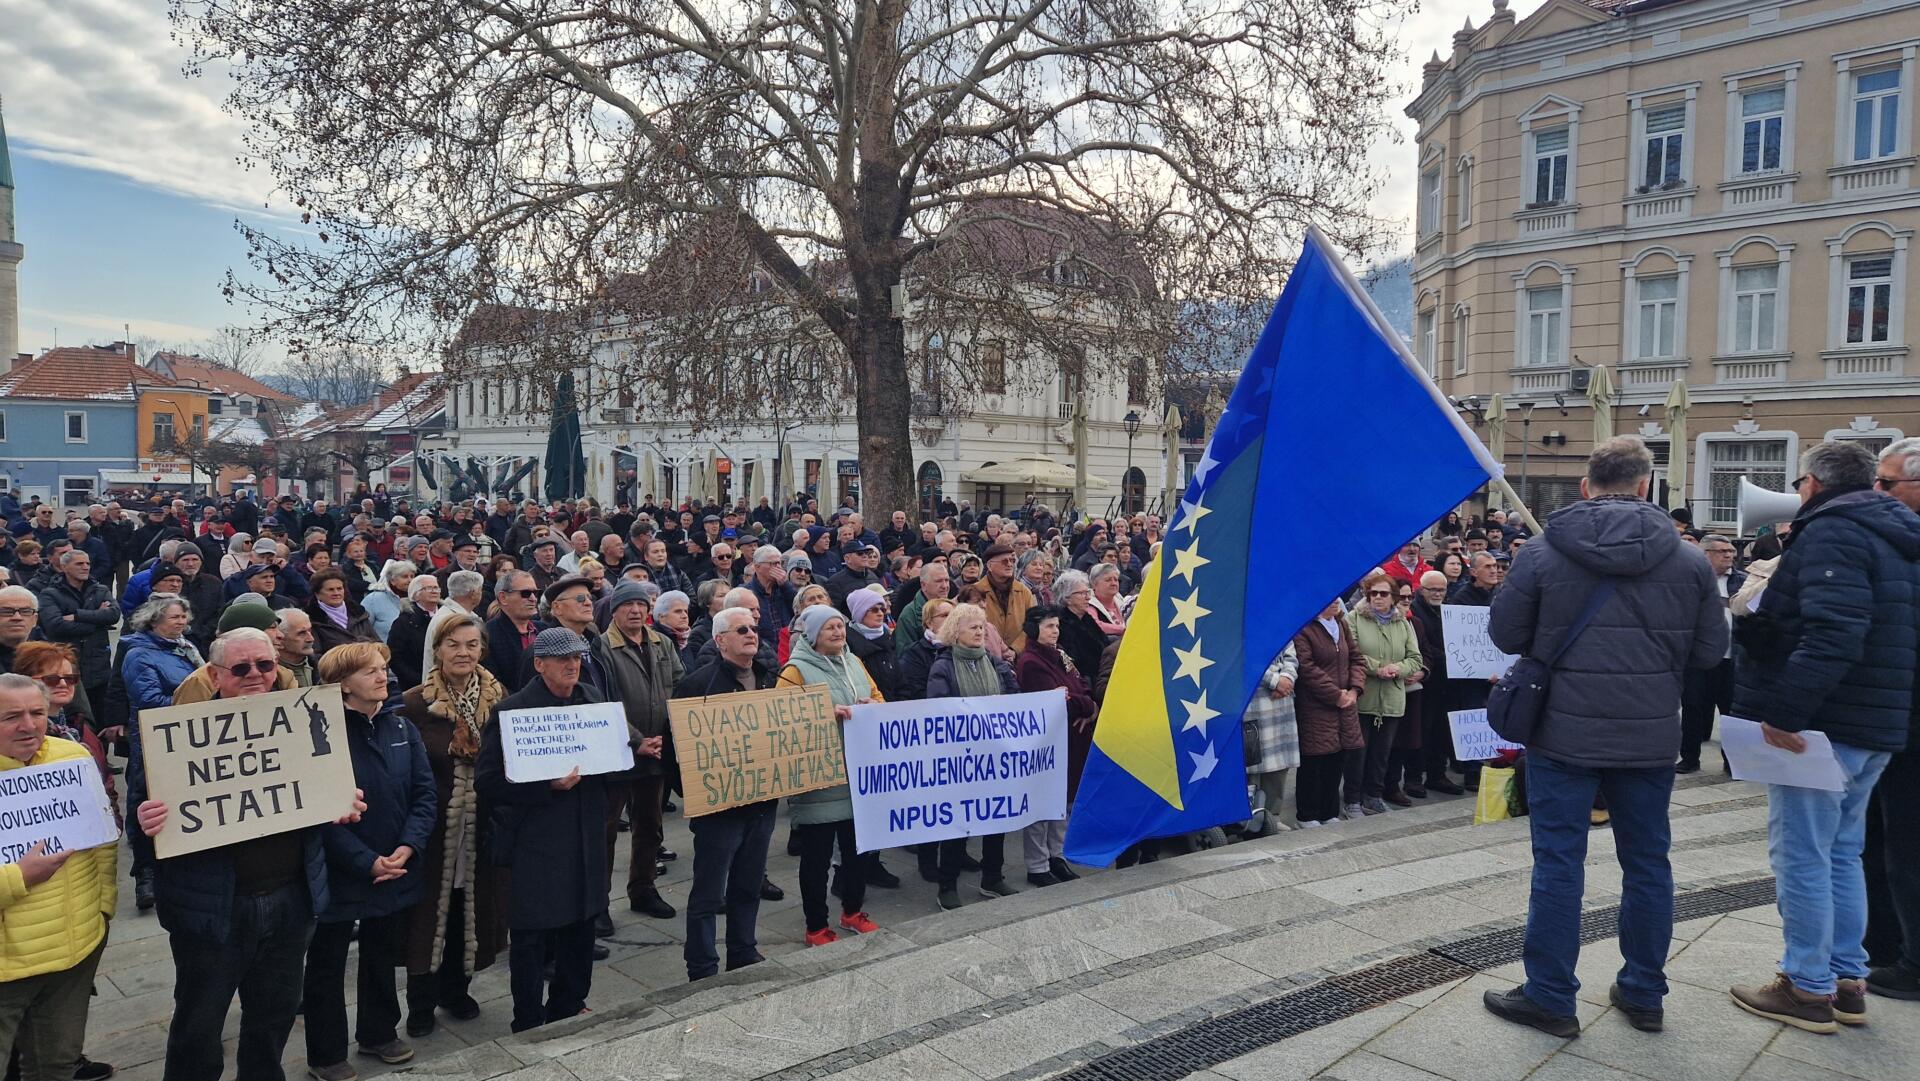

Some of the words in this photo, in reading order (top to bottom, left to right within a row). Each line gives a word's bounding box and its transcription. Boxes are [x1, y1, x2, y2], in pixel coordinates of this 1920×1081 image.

[840, 466, 857, 474] WHITE
[153, 706, 293, 753] TUZLA
[687, 703, 759, 738] OVAKO
[765, 691, 826, 728] NEĆETE
[879, 718, 921, 750] NOVA
[924, 710, 1041, 745] PENZIONERSKA
[187, 743, 281, 786] NEĆE
[517, 744, 588, 757] PENZIONERIMA
[858, 748, 996, 795] UMIROVLJENIČKA
[1000, 745, 1055, 779] STRANKA
[770, 762, 783, 794] A
[179, 781, 304, 833] STATI
[889, 802, 953, 832] NPUS
[960, 793, 1029, 822] TUZLA
